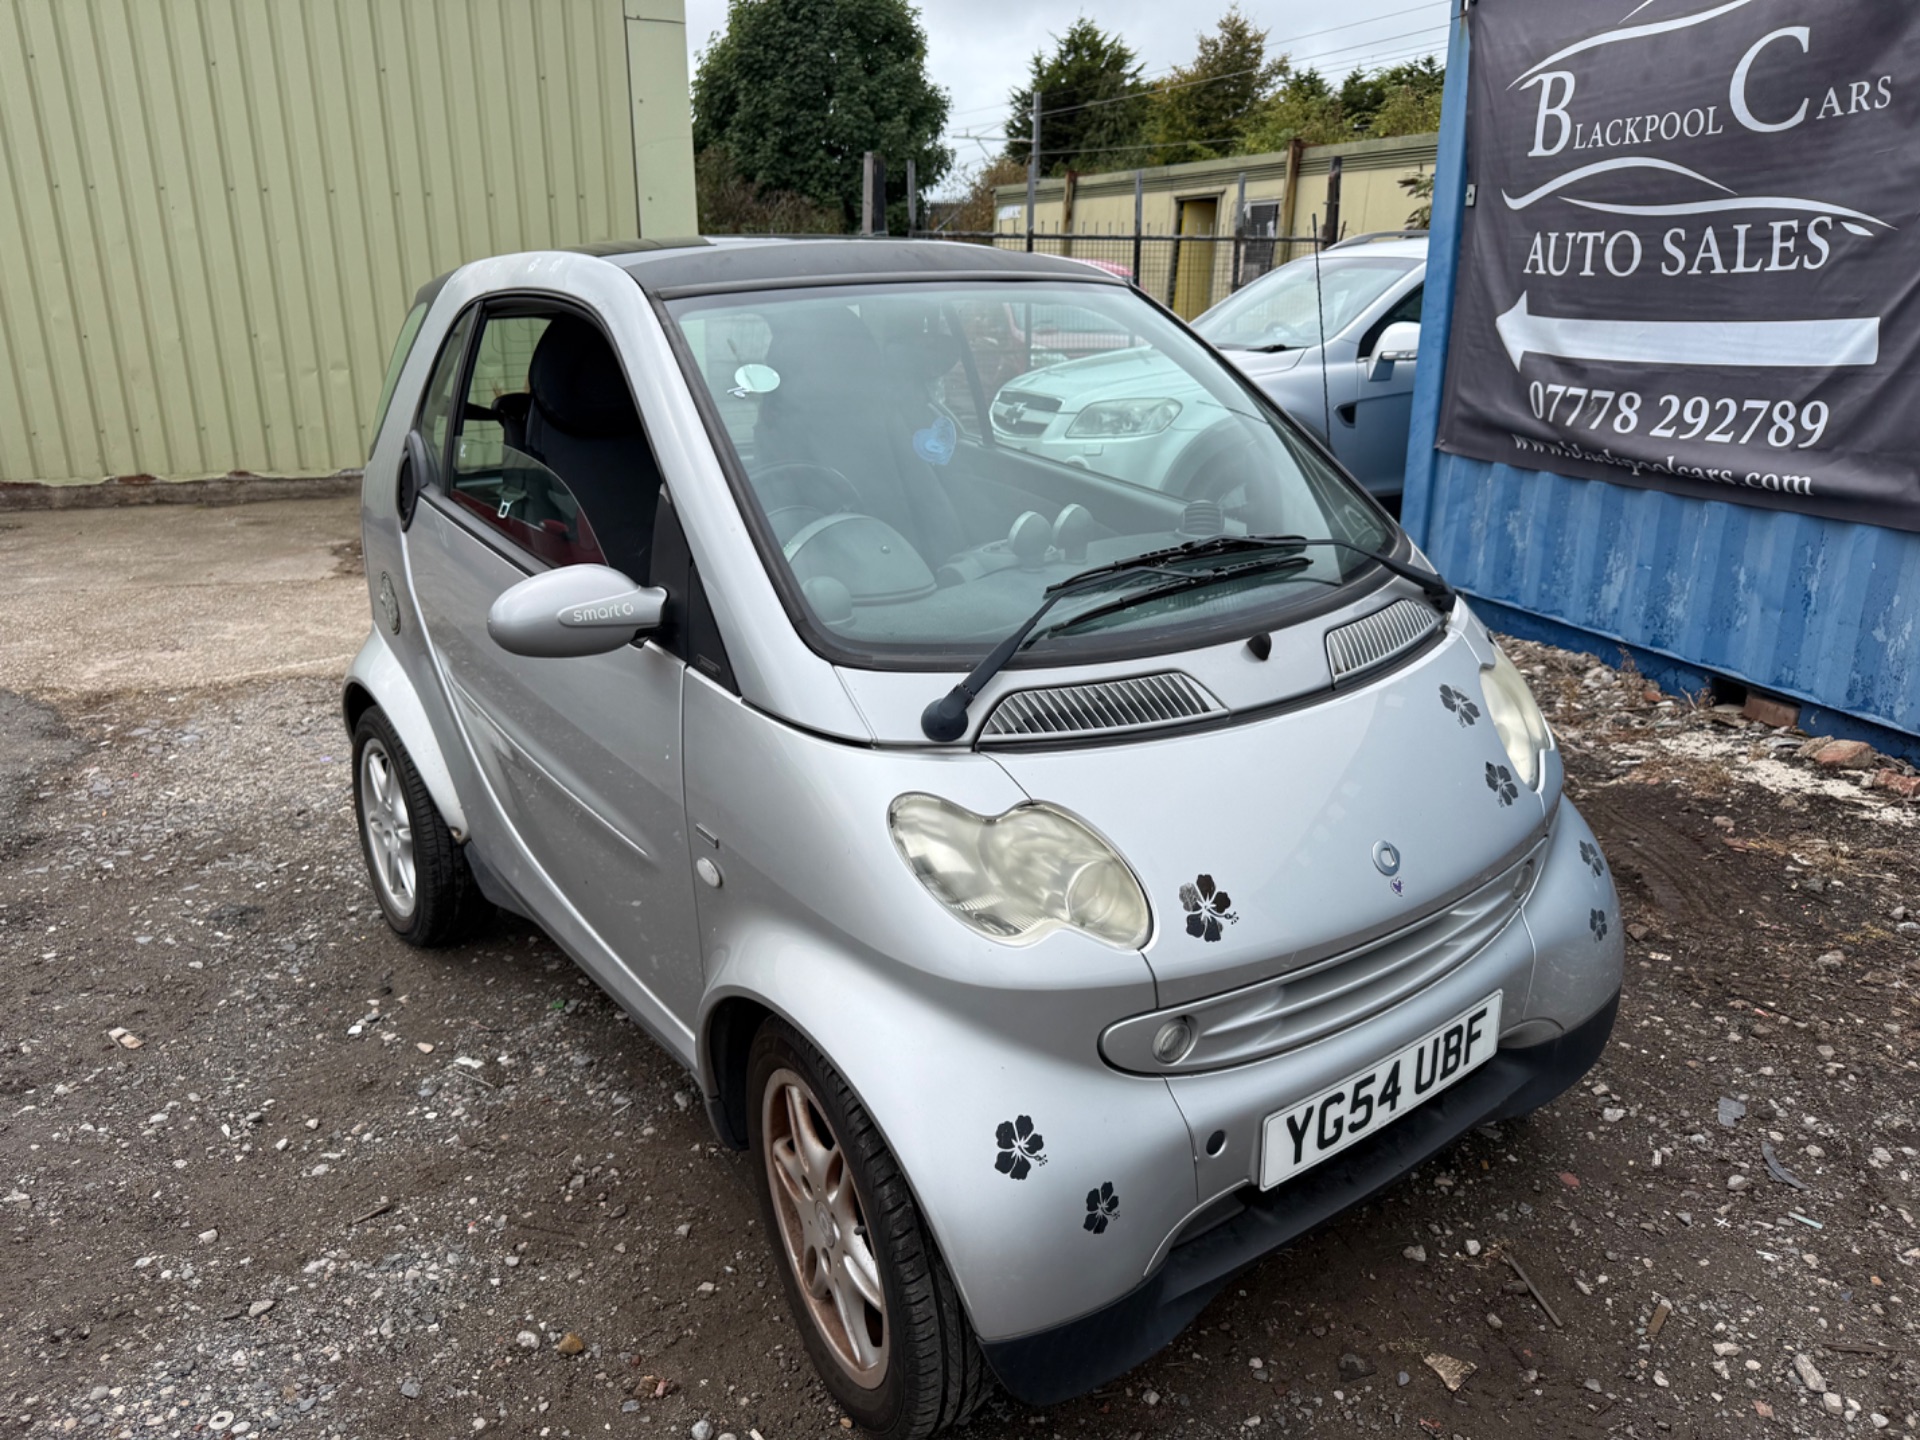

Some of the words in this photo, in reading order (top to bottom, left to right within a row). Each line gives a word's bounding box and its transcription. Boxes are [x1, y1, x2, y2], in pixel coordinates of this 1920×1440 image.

[1527, 70, 1724, 158] BLACKPOOL
[1728, 26, 1893, 133] CARS
[1522, 229, 1643, 278] AUTO
[1660, 215, 1834, 278] SALES
[1529, 380, 1643, 434] 07778
[1649, 394, 1830, 449] 292789
[573, 603, 621, 623] smart
[1286, 1059, 1401, 1165] YG54
[1414, 1007, 1488, 1095] UBF
